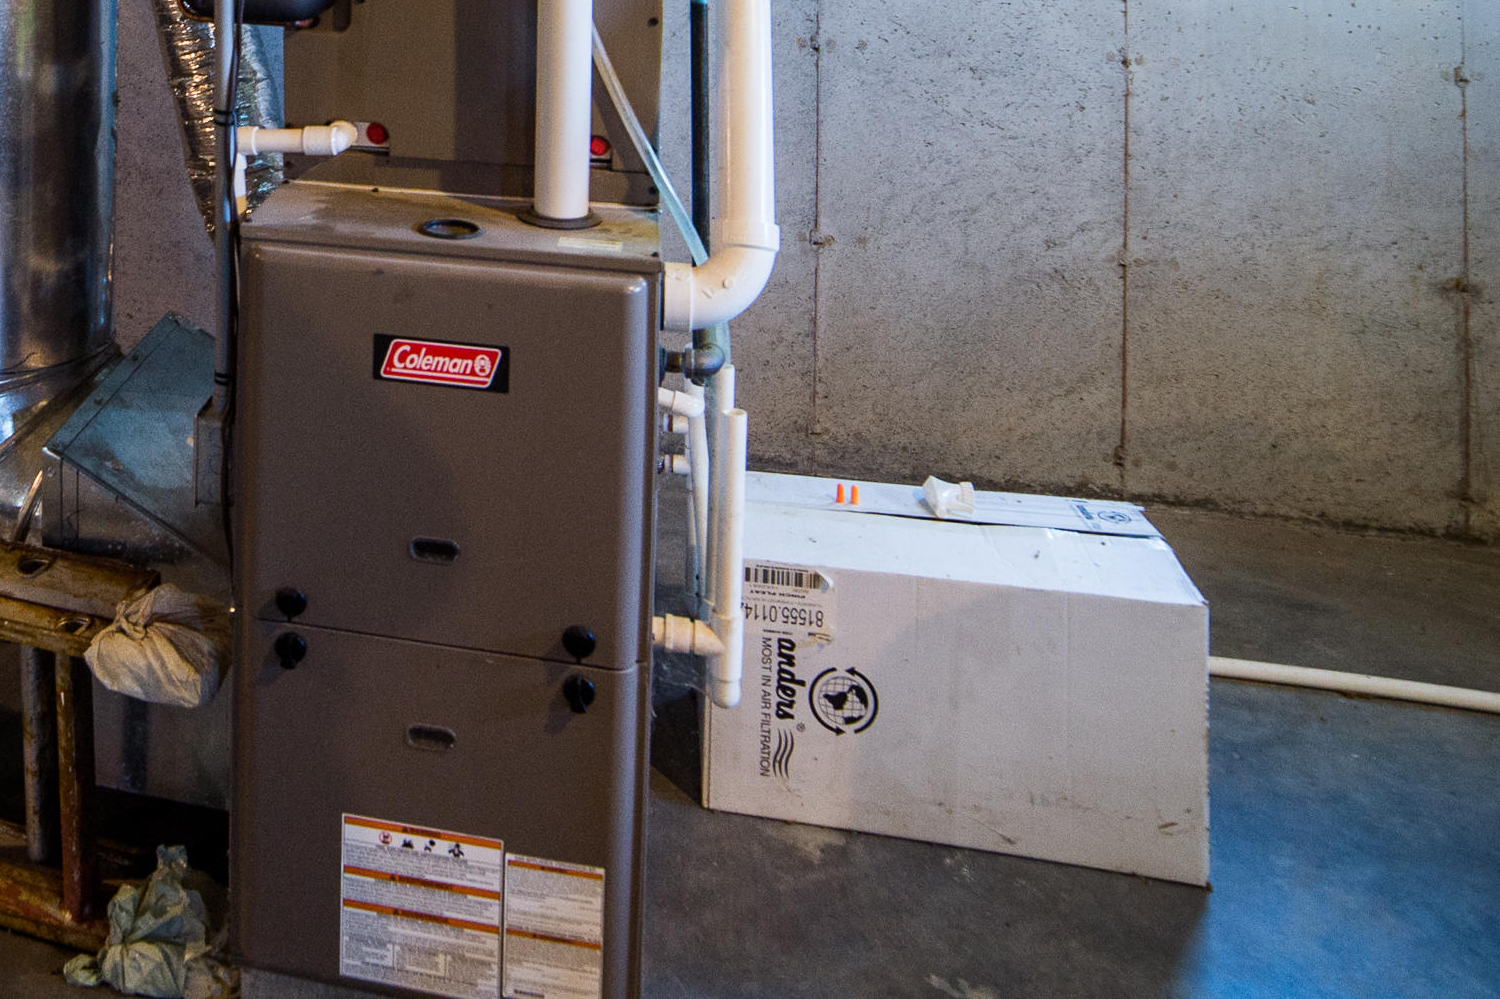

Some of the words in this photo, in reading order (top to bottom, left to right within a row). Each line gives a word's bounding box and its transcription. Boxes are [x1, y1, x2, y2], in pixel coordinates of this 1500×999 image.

[392, 344, 473, 375] Coleman
[740, 602, 824, 628] 81555.0114
[760, 637, 773, 672] MOST
[761, 674, 772, 687] IN
[760, 689, 772, 710] AIR
[759, 712, 772, 778] FILTRATION
